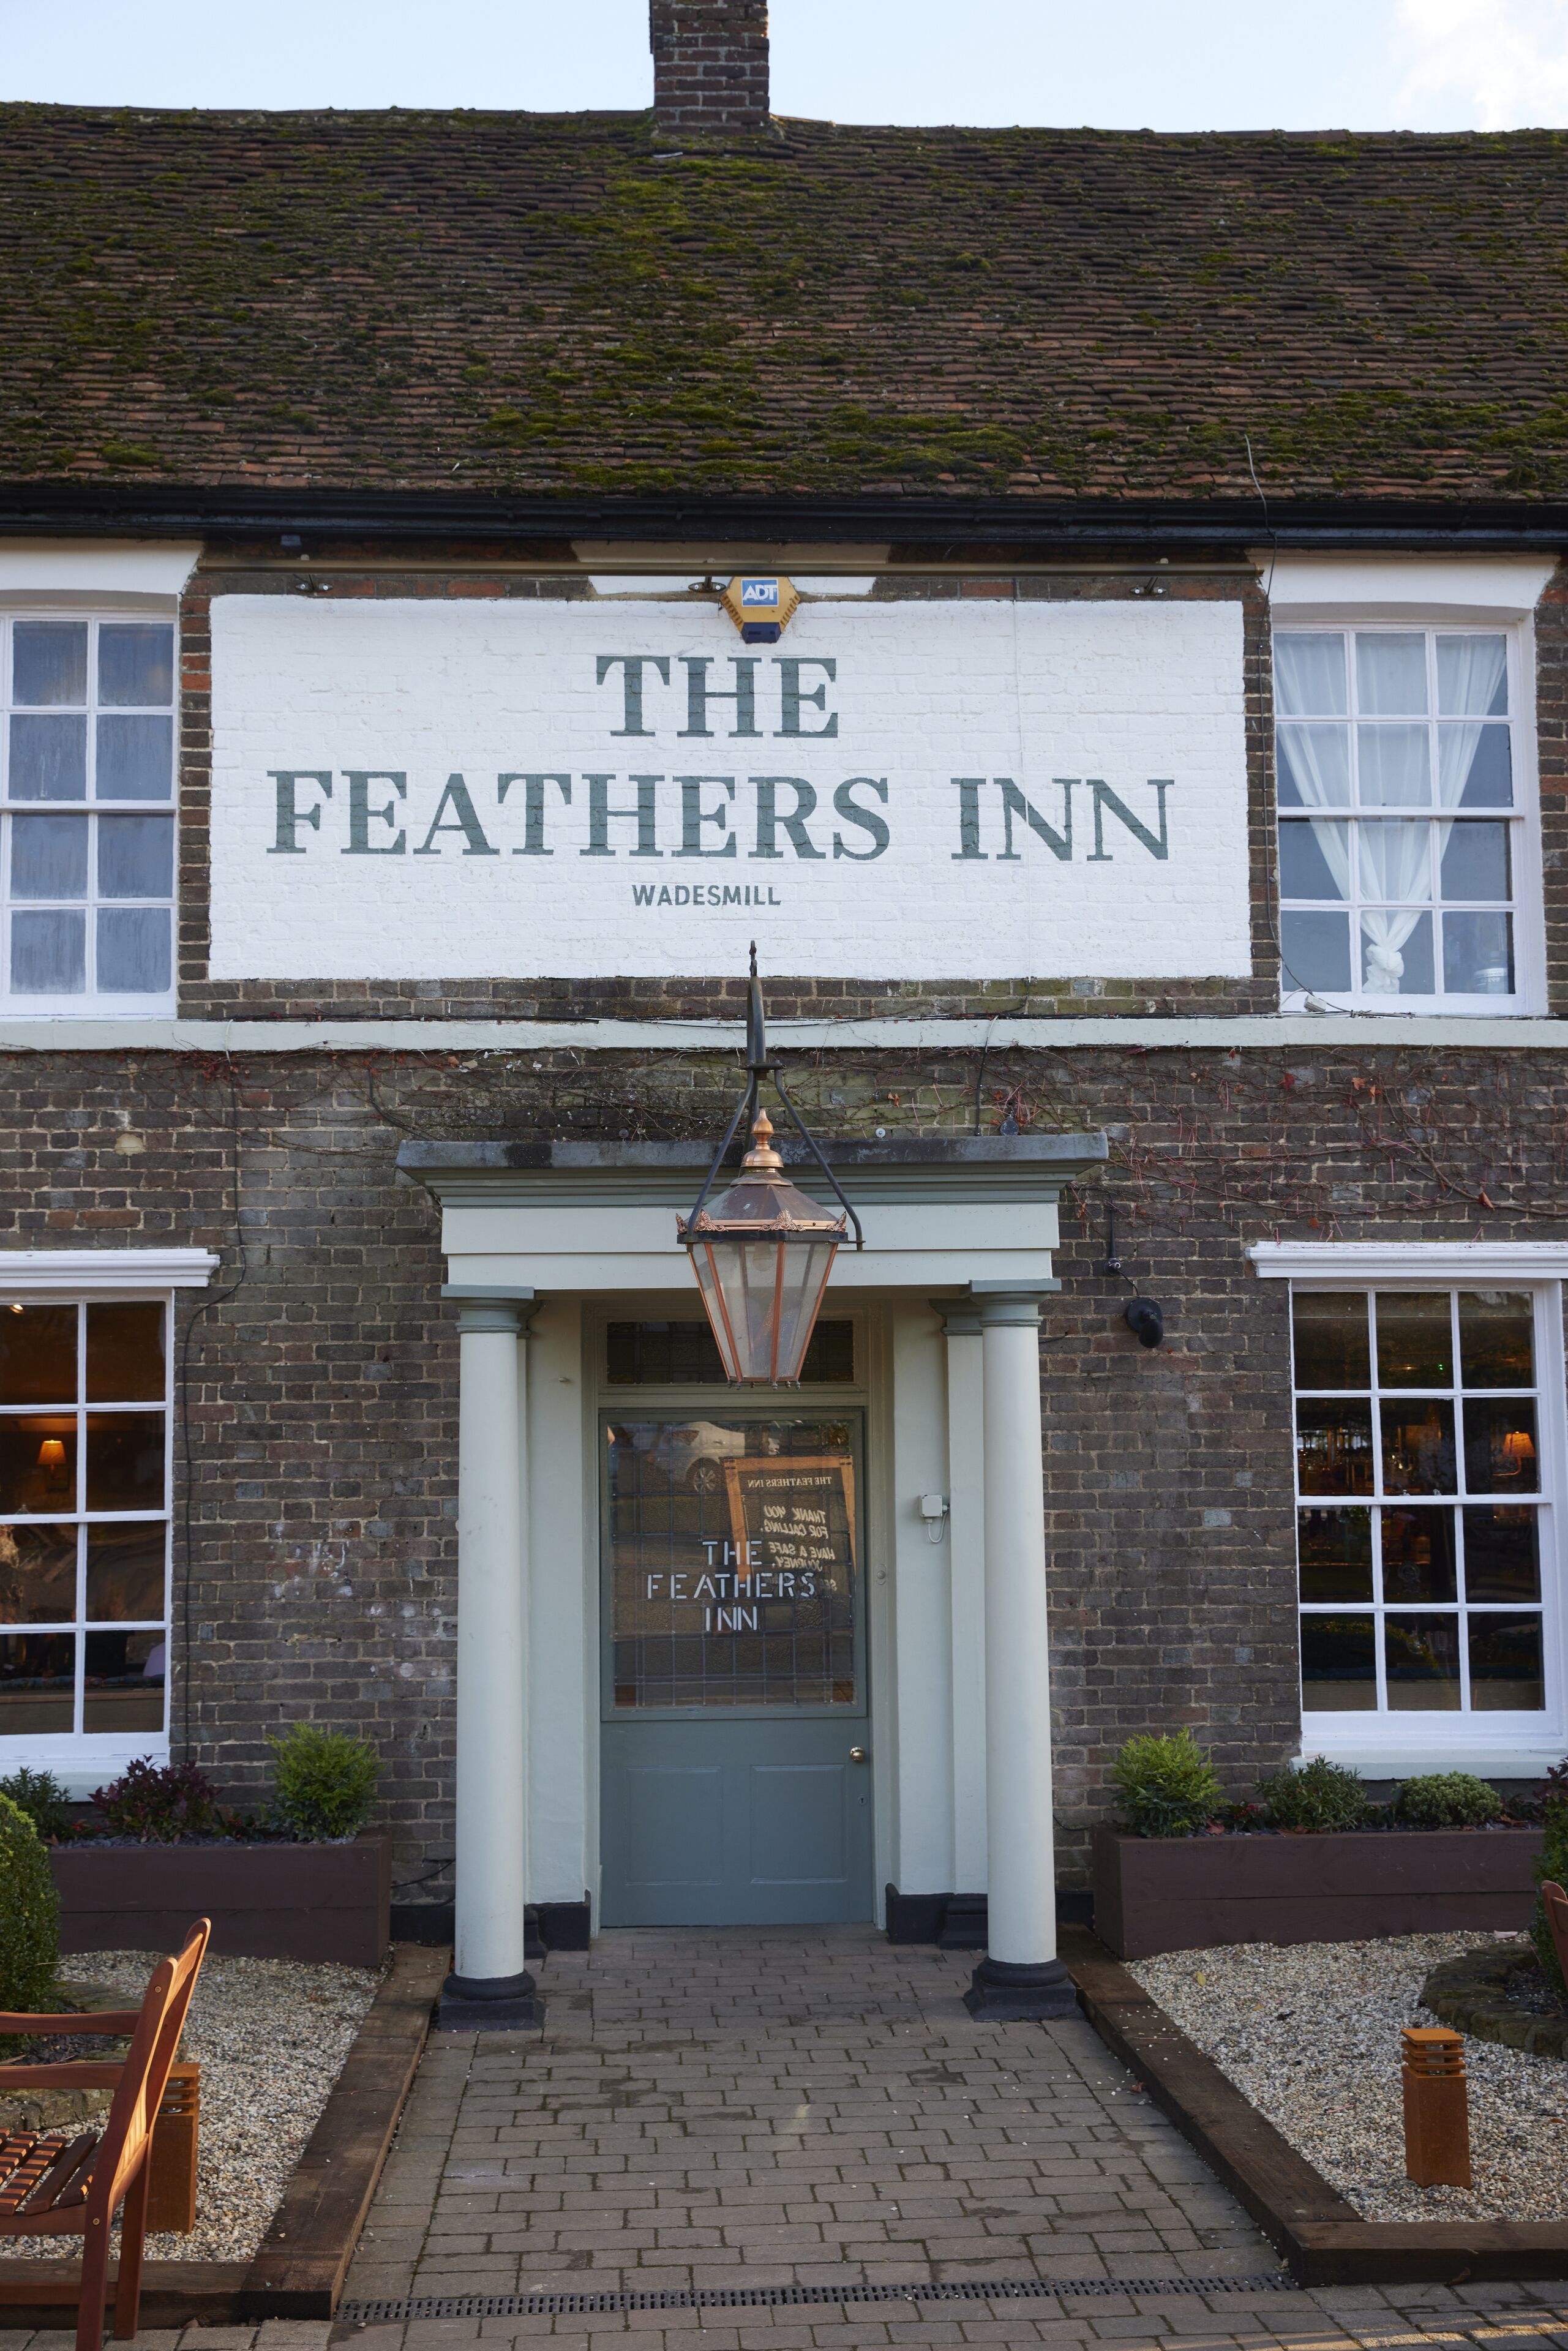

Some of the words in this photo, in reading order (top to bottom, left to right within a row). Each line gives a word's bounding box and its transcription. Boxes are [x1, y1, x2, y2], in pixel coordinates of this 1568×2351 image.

[743, 584, 778, 601] ADT
[597, 656, 838, 737] THE
[266, 771, 890, 860] FEATHERS
[951, 778, 1174, 861] INN
[632, 885, 781, 906] WADESMILL
[702, 1540, 763, 1565] THE
[647, 1572, 815, 1599] FEATHERS
[706, 1606, 757, 1632] INN
